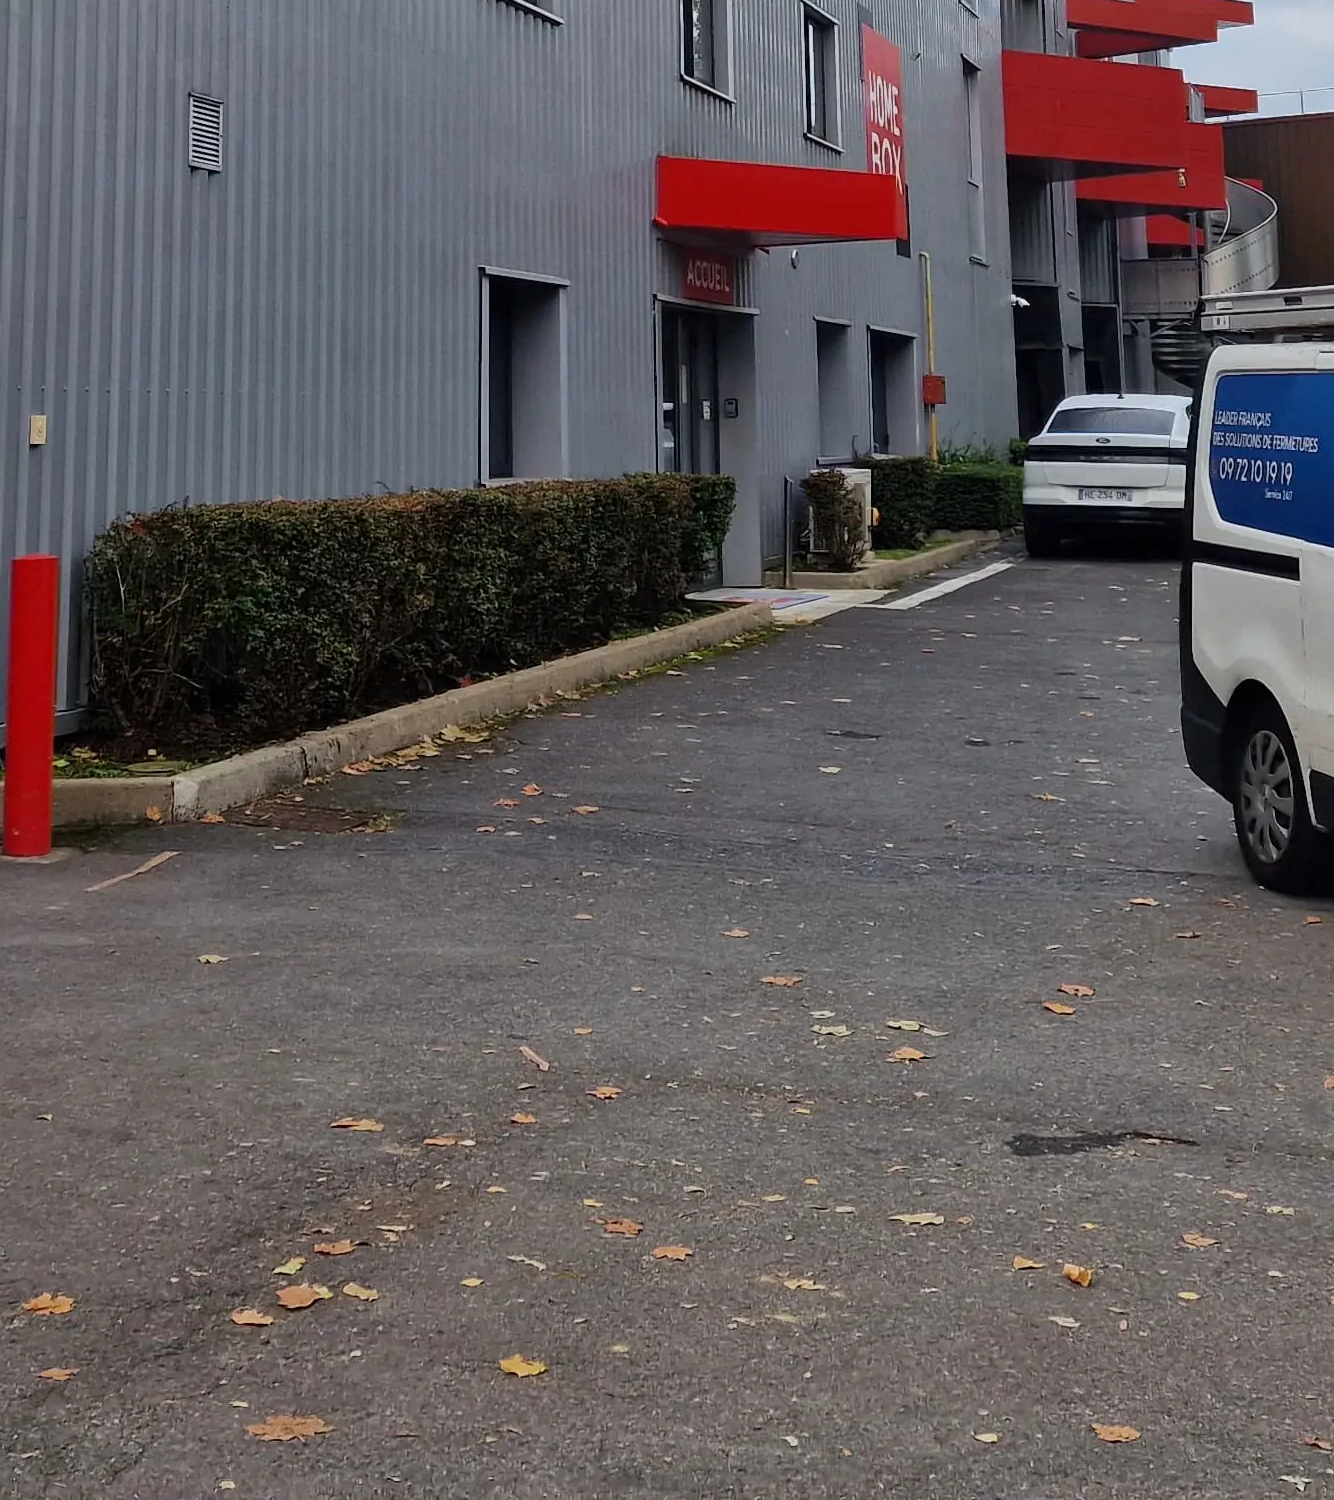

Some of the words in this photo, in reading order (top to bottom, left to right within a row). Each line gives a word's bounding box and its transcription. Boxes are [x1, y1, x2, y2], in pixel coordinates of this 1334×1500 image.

[869, 70, 901, 137] HOME
[871, 131, 903, 195] BOX
[687, 258, 730, 293] ACCUEIL
[1215, 411, 1237, 425] LEADER
[1238, 412, 1272, 430] FRANÇAIS
[1213, 432, 1224, 445] DES
[1225, 433, 1261, 448] SOLUTIONS
[1262, 435, 1272, 449] DE
[1219, 457, 1234, 480] 09
[1235, 458, 1248, 482] 72
[1250, 459, 1263, 483] 10
[1266, 460, 1278, 485] 19
[1280, 462, 1293, 486] 19
